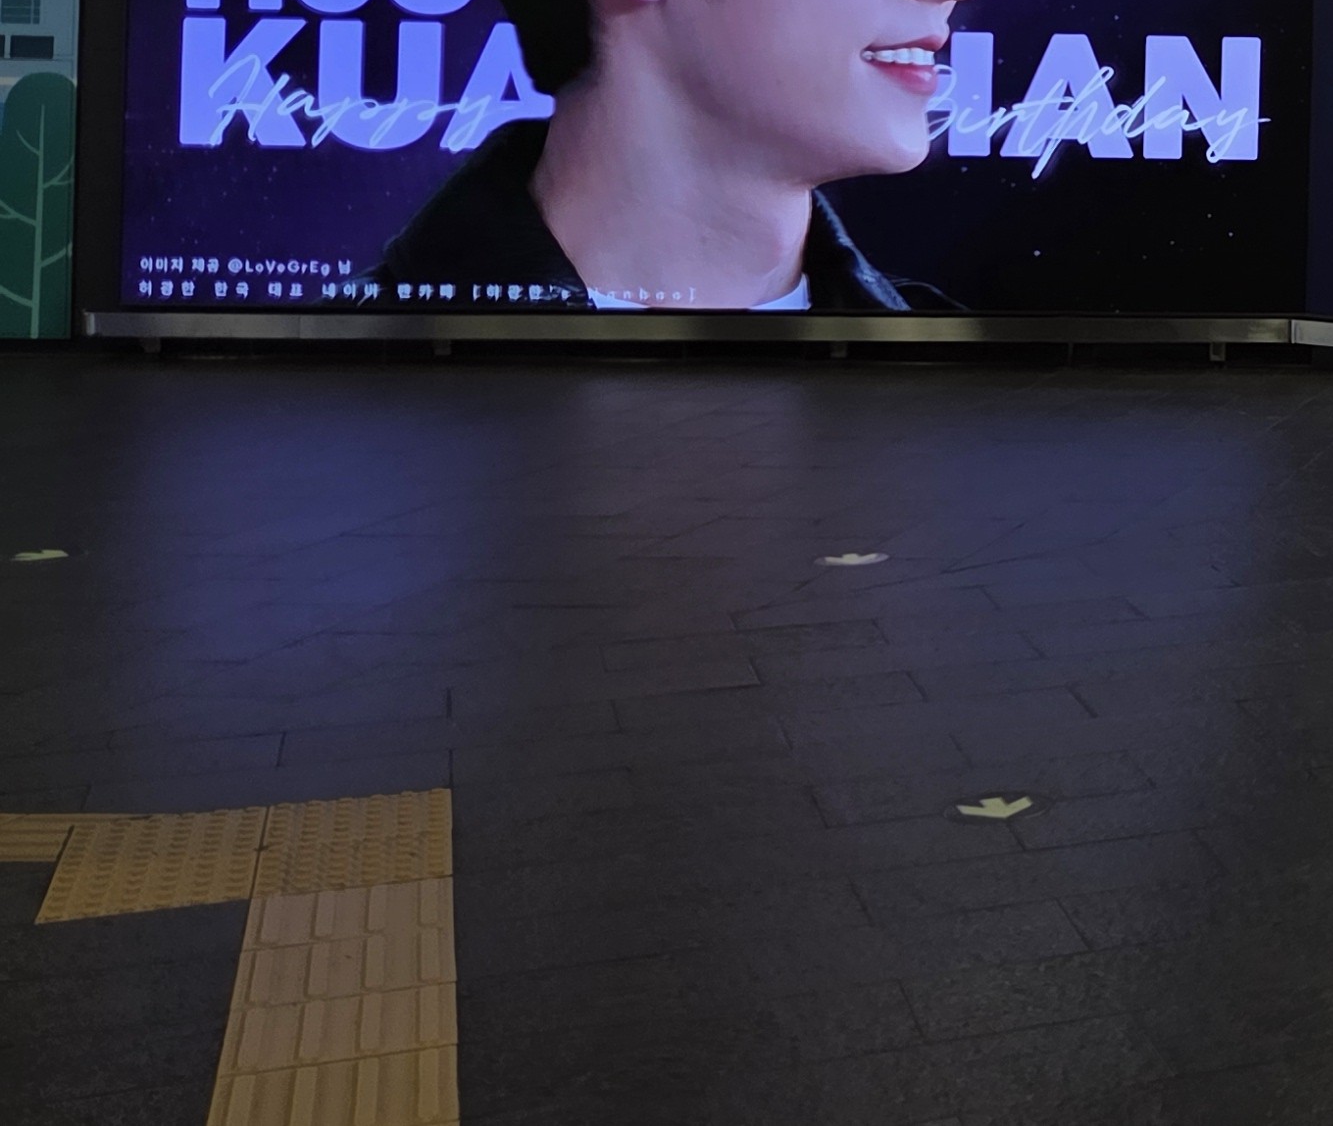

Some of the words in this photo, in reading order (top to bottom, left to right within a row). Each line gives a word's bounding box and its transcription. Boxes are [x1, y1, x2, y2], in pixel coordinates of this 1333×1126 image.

[208, 53, 495, 154] Happy
[926, 63, 1272, 180] Birthday
[139, 256, 184, 274] 이미지
[191, 257, 220, 274] 제공
[139, 279, 196, 298] 허광한
[214, 279, 249, 299] 한국
[267, 281, 304, 298] 대표
